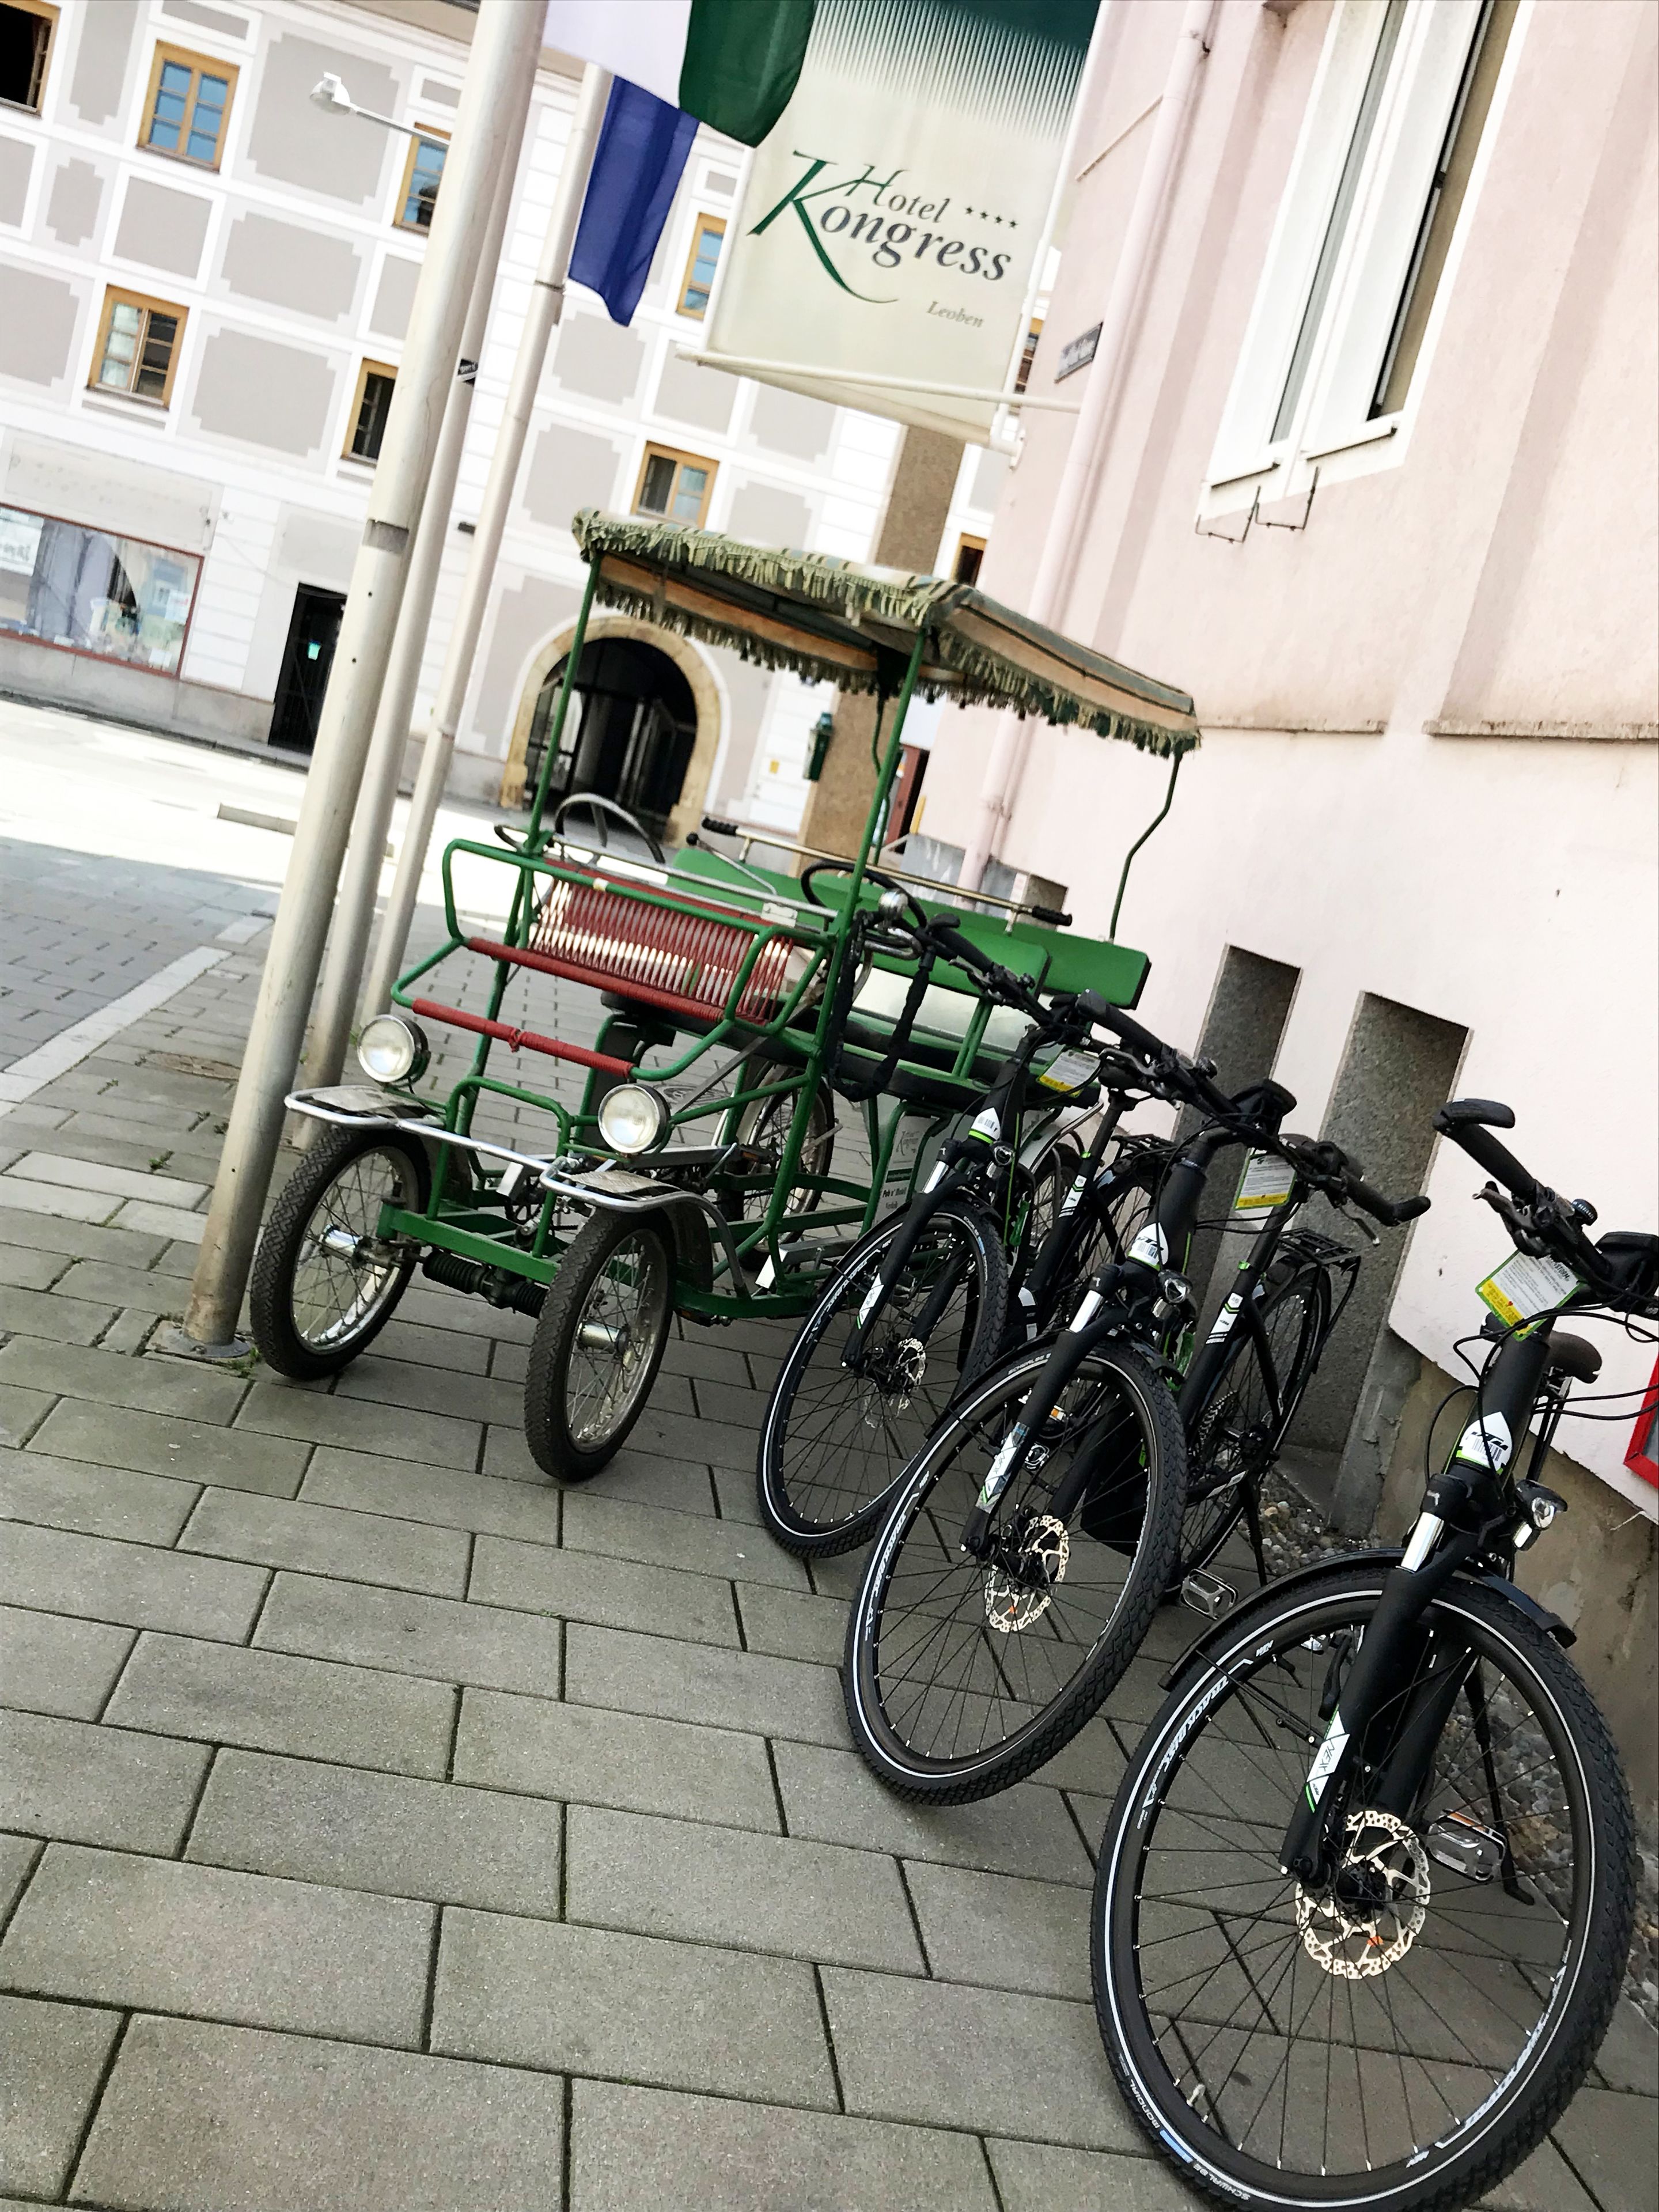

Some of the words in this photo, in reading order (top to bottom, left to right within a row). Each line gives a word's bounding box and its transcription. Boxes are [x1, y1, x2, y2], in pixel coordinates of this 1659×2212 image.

[845, 164, 950, 223] Hotel
[746, 150, 1012, 304] Kongress
[927, 301, 984, 329] Leoben
[1193, 2163, 1251, 2201] SCHWALBE
